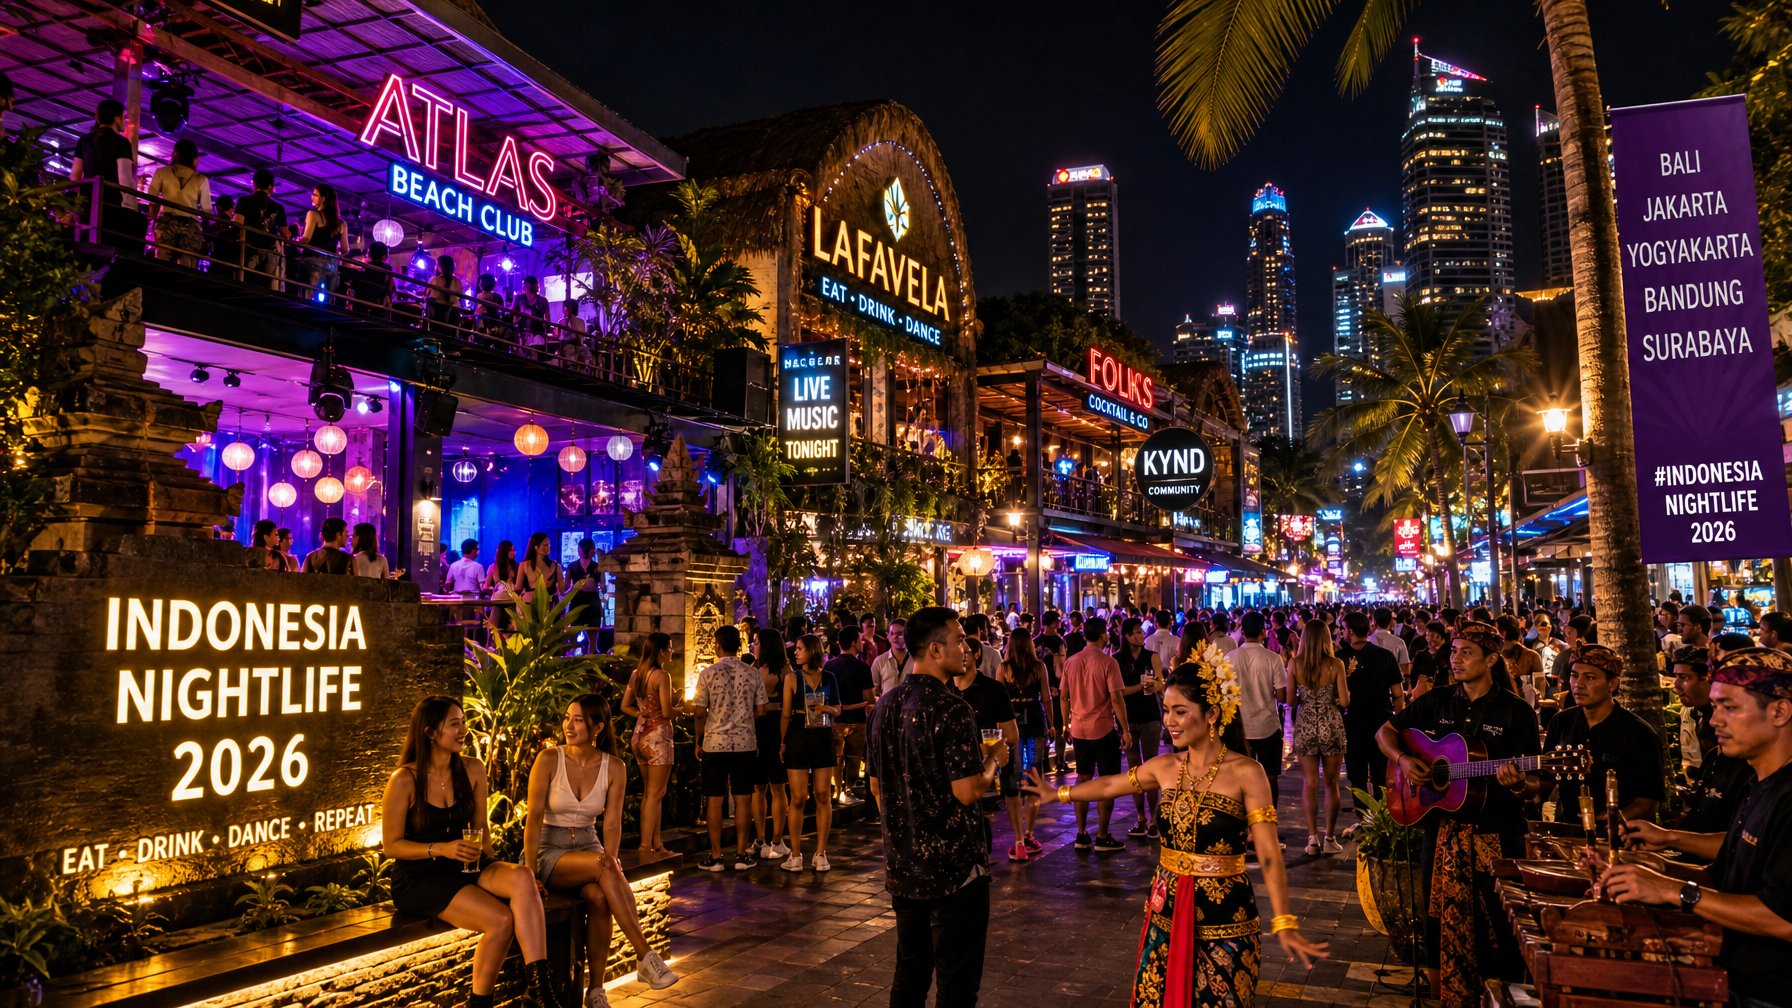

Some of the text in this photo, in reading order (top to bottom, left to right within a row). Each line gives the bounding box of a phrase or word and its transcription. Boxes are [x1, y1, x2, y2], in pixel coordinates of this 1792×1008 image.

[360, 73, 556, 221] ATLAS
[1660, 149, 1701, 176] BALI
[392, 164, 533, 247] BEACH CLUB
[1643, 190, 1728, 222] JAKARTA
[813, 205, 950, 322] LAFAVELA
[1627, 232, 1754, 267] YOGYAKARTA
[822, 276, 941, 346] EAT DRINK DANCE
[1644, 279, 1744, 313] BANDUNG
[1642, 326, 1753, 362] SURABAYA
[794, 375, 831, 401] LIVE
[786, 405, 838, 431] MUSIC
[1088, 393, 1148, 430] COCKTAIL & CO
[785, 439, 839, 460] TONIGHT
[1143, 448, 1205, 476] KYND
[1148, 484, 1200, 496] COMMUNITY
[1654, 460, 1763, 486] #INDONESIA
[1665, 489, 1759, 516] NIGHTLIFE
[1690, 520, 1736, 543] 2026
[105, 596, 368, 652] INDONESIA
[116, 665, 362, 725] NIGHTLIFE
[171, 733, 310, 802] 2026
[62, 804, 375, 875] EAT DRINK DANCE REPEAT
